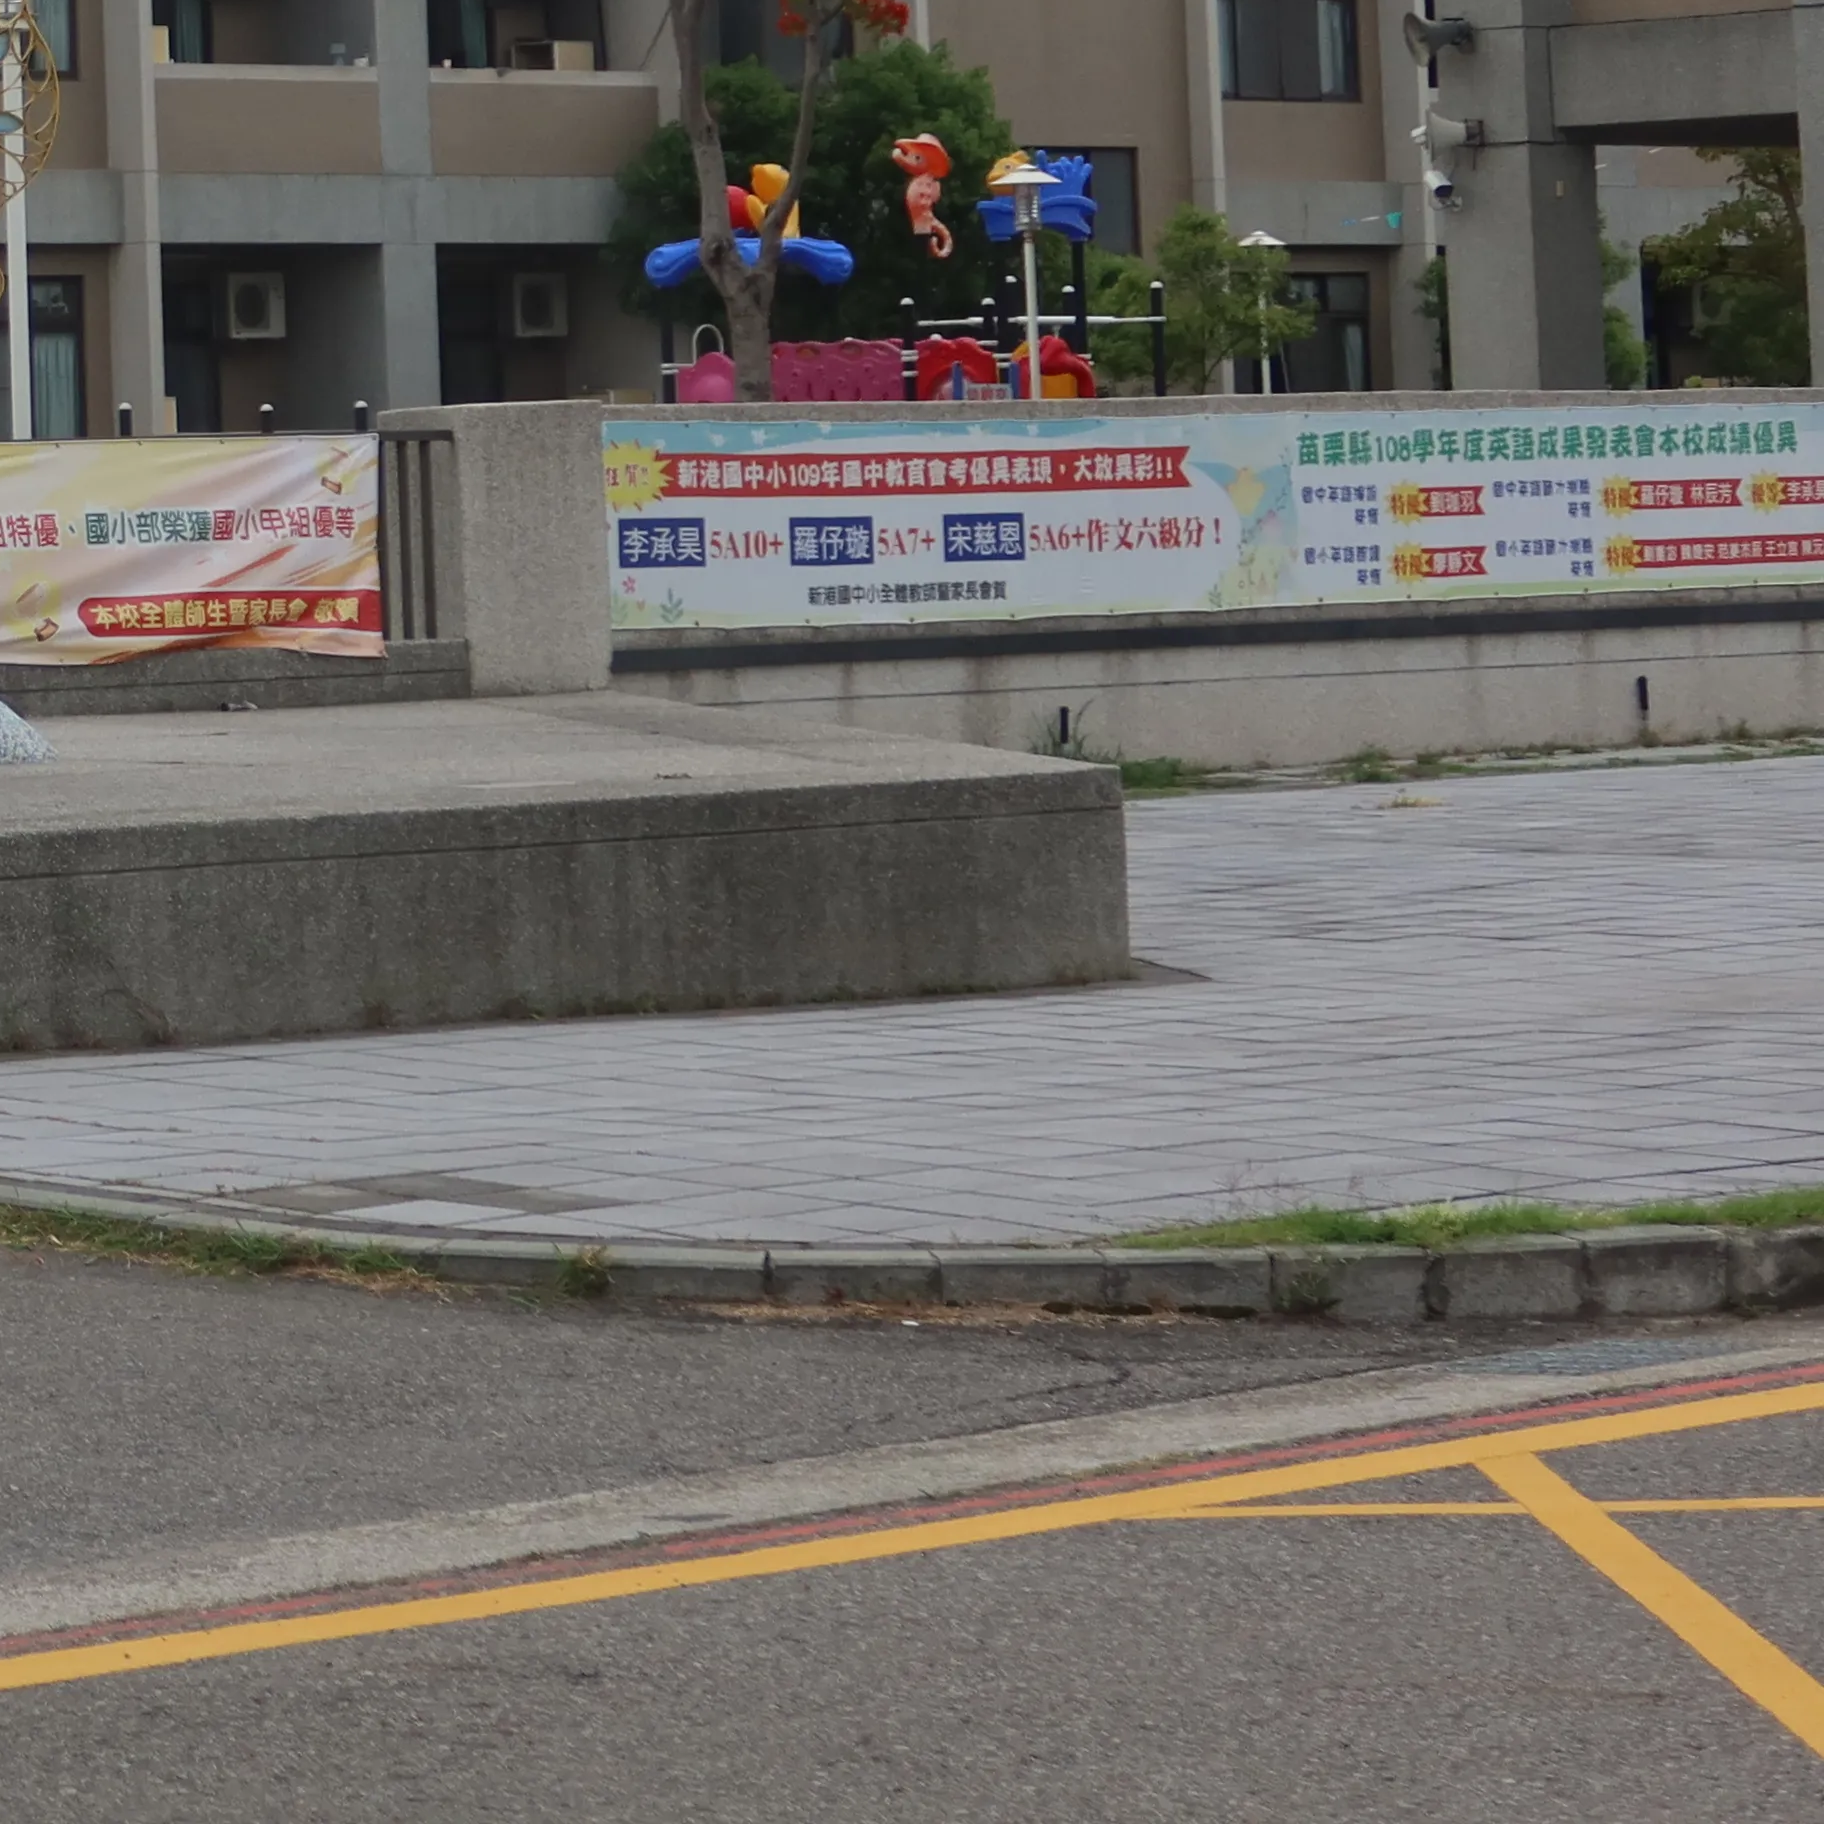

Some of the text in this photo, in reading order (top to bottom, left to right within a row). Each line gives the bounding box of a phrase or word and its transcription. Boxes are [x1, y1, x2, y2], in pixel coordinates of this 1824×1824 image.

[622, 526, 703, 562] 李承昊
[710, 530, 784, 559] 5A10+
[877, 526, 936, 557] 5A7+
[948, 521, 1023, 557] 宋慈恩
